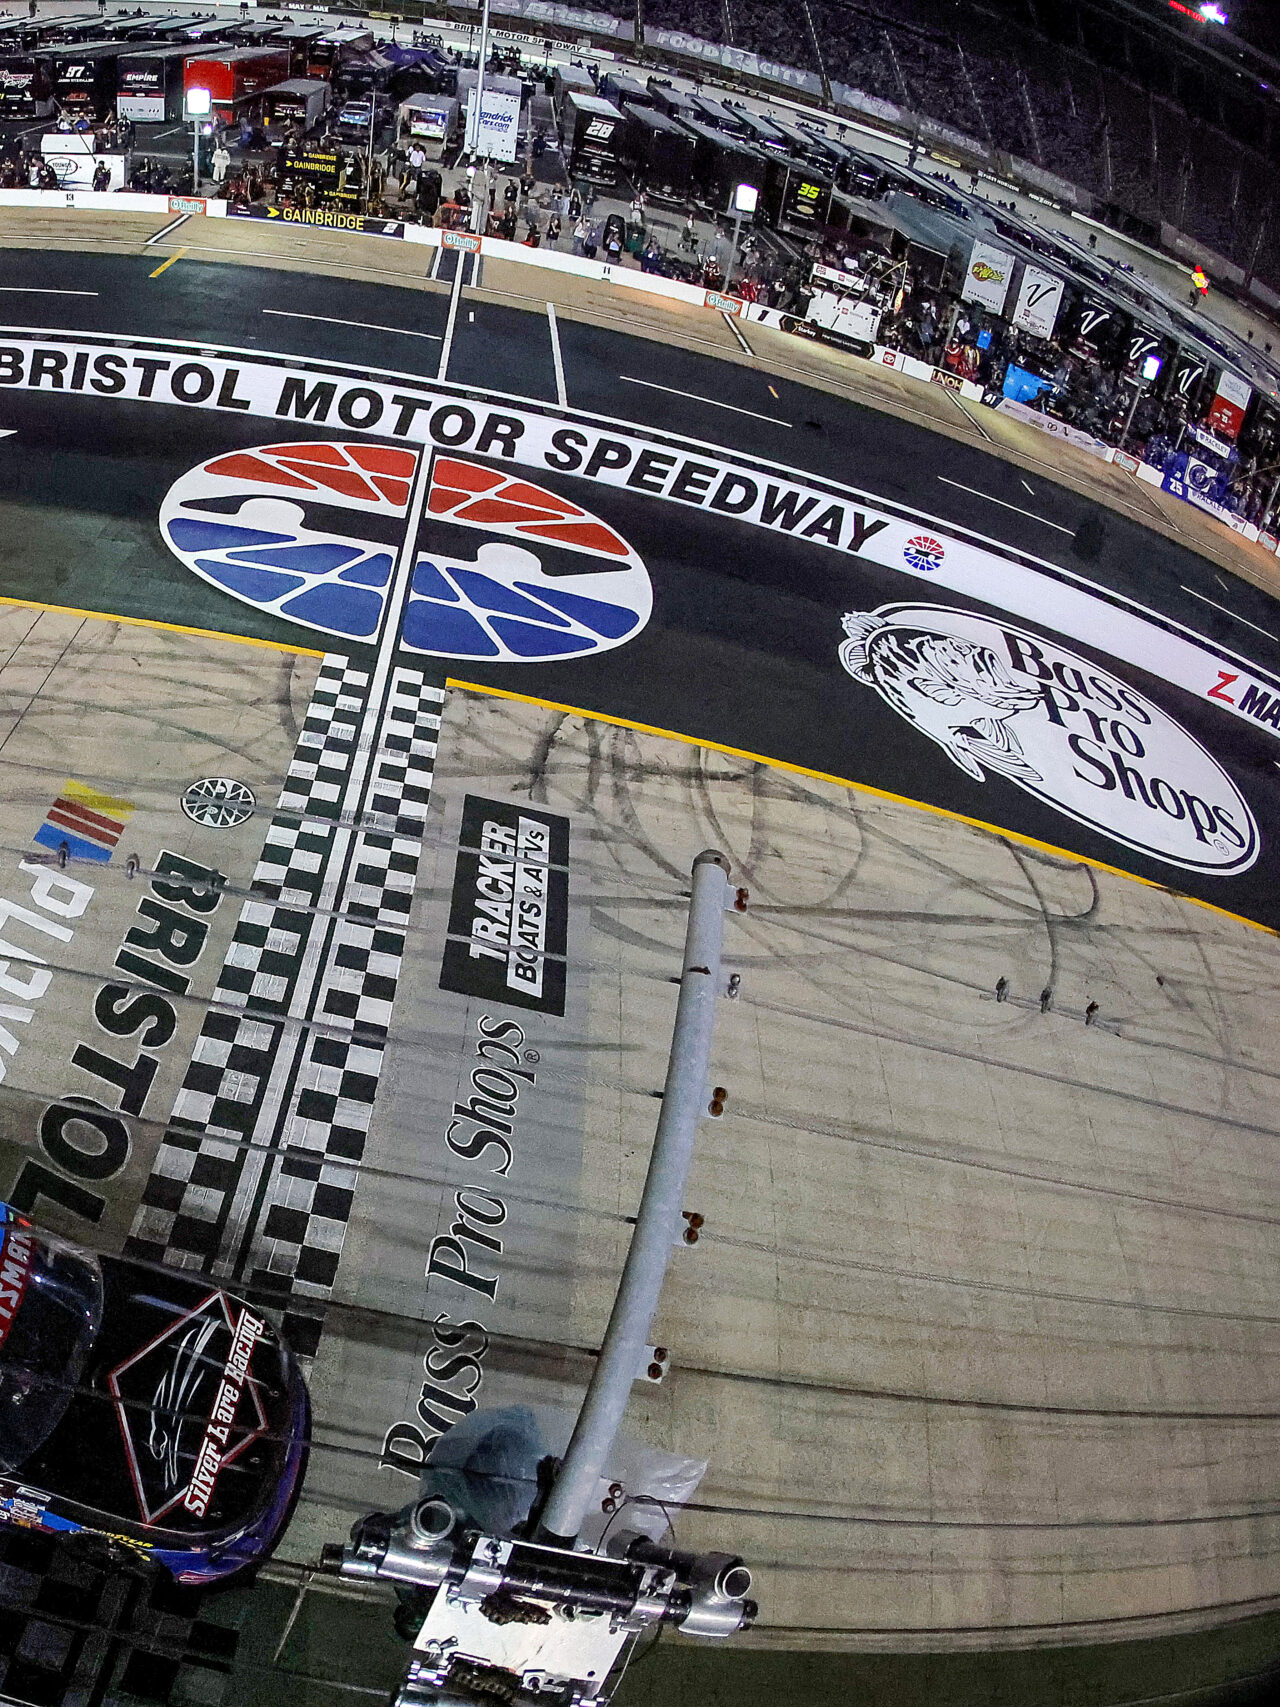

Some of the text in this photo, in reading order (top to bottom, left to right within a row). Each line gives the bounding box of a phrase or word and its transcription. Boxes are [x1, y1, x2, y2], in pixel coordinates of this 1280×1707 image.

[453, 22, 583, 53] BRISTL MOTOR SPDWAY
[126, 73, 159, 82] EMPIRE
[308, 152, 337, 162] GAINBRIDGE
[586, 121, 616, 139] 28
[293, 160, 336, 173] GAINBRIDGE
[797, 182, 821, 200] 35
[282, 208, 365, 231] GAINBRIDGE
[932, 370, 964, 391] UNOH
[983, 393, 997, 404] 41
[275, 377, 529, 464] MOTOR
[543, 428, 895, 554] SPEEDWAY
[1000, 628, 1153, 726] Bass
[1038, 683, 1145, 760] Pro
[1067, 732, 1247, 851] Shops
[469, 819, 517, 962] TRACKER
[514, 830, 546, 985] BOATS & ATVs
[8, 848, 230, 1225] BRISTOL
[377, 1013, 537, 1481] Bass Pro Shops
[184, 1436, 223, 1518] Silver
[224, 1307, 265, 1386] Racing
